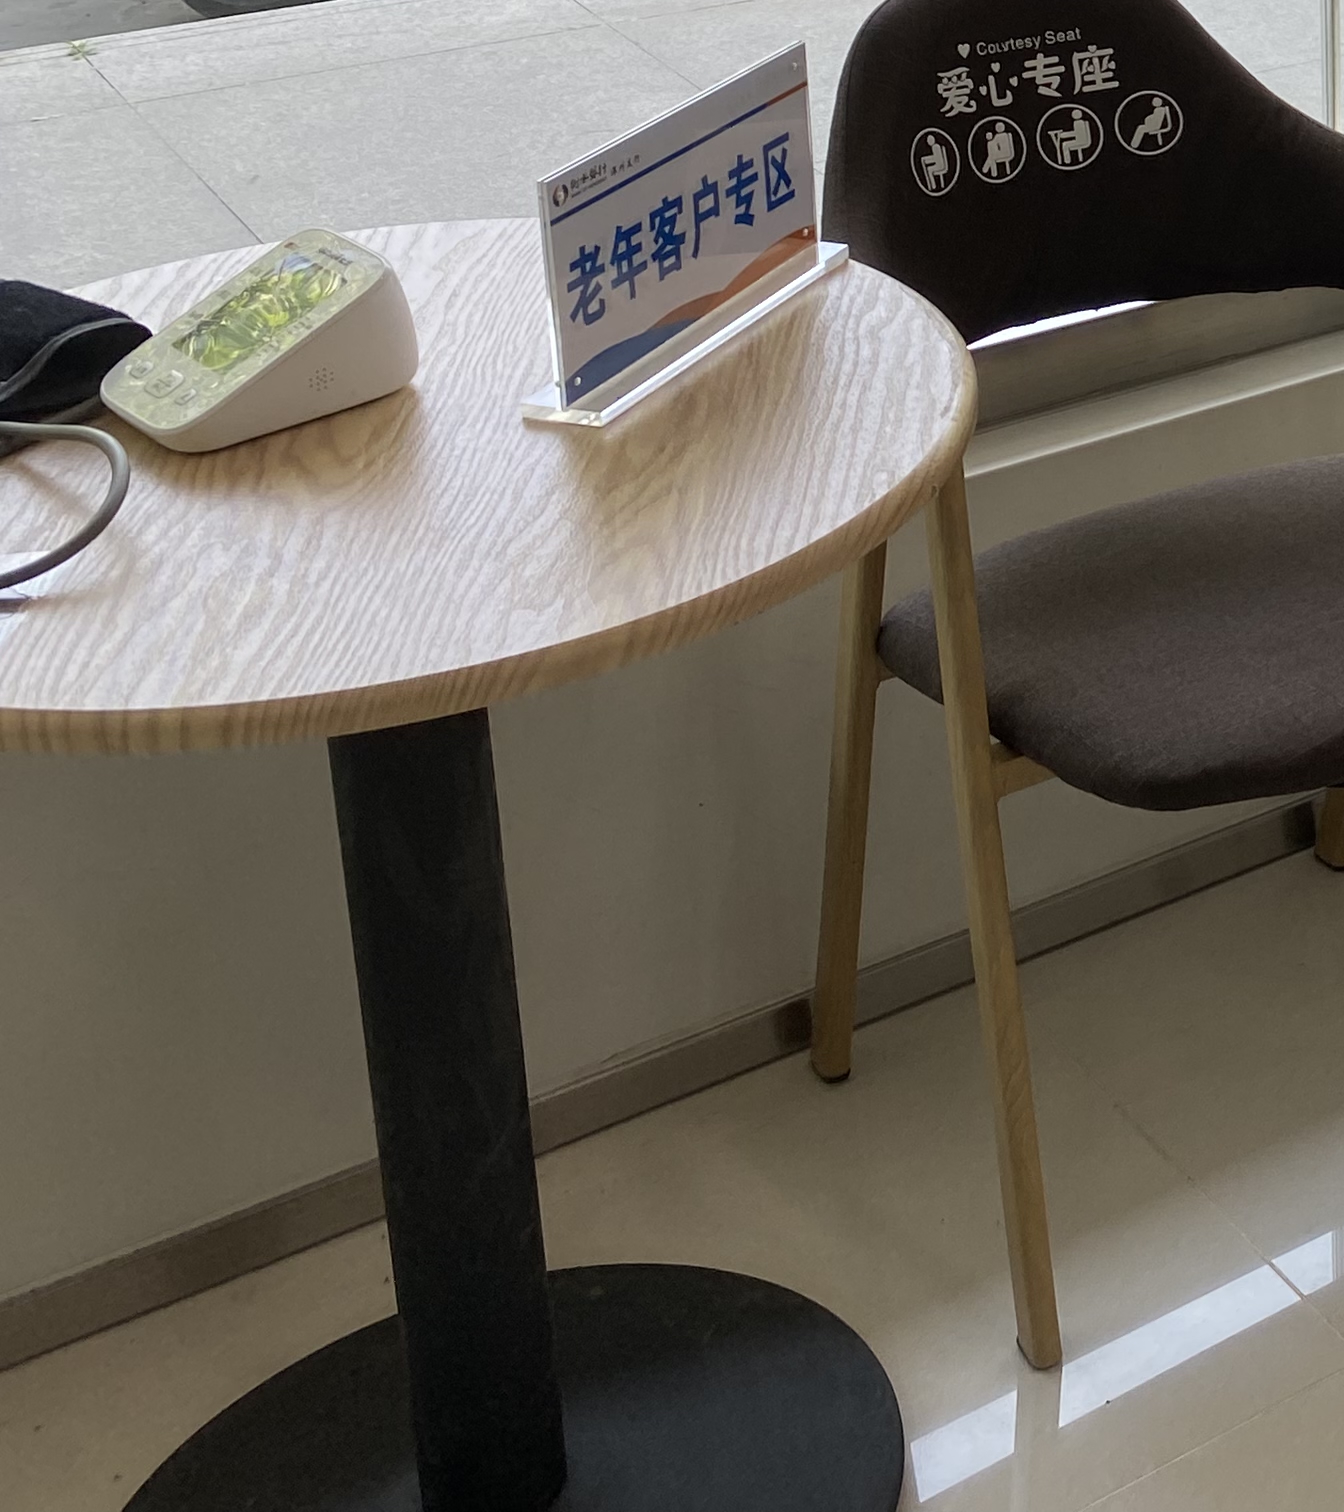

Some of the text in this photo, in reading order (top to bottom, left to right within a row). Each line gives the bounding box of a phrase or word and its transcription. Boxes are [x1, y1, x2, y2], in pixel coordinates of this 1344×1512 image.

[976, 26, 1082, 56] Courtesy Seat
[936, 44, 1120, 118] 爱心专座
[567, 131, 796, 326] 老年客户专区
